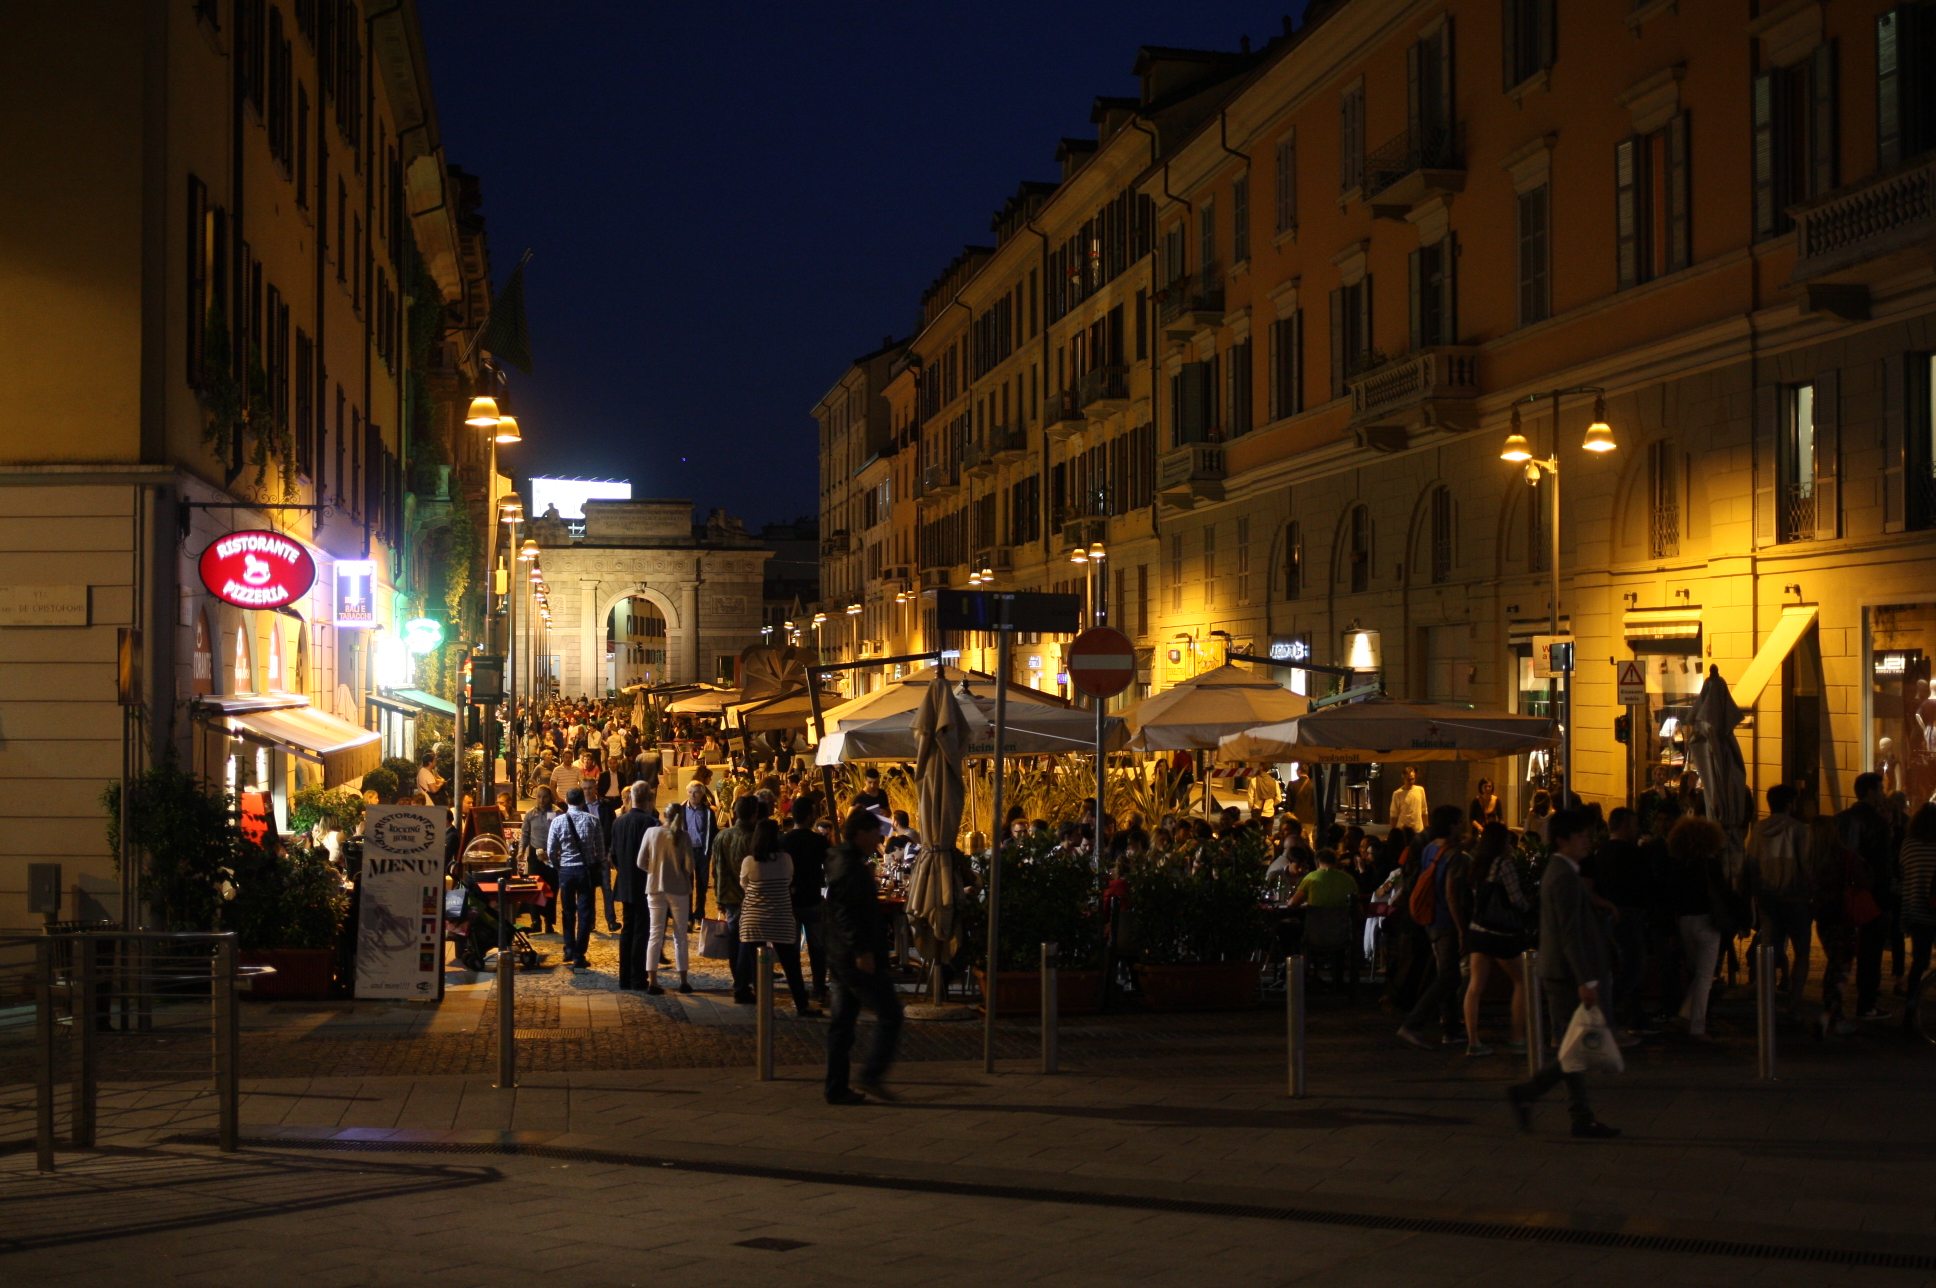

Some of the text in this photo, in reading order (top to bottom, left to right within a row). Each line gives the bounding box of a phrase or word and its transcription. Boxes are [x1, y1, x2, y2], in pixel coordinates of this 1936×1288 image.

[216, 535, 300, 565] RISTORANTE
[338, 564, 371, 606] T
[222, 579, 290, 605] PIZZERIA
[19, 604, 29, 612] DE
[32, 604, 85, 613] CRISTOFORIS
[361, 605, 366, 613] E
[339, 612, 372, 621] TABACCHI
[1412, 738, 1456, 748] Heineken
[374, 812, 435, 830] RISTORANTE
[388, 823, 421, 833] ROCKING
[392, 835, 416, 843] HORSE
[375, 839, 434, 855] PIZZERIA
[370, 980, 382, 990] and
